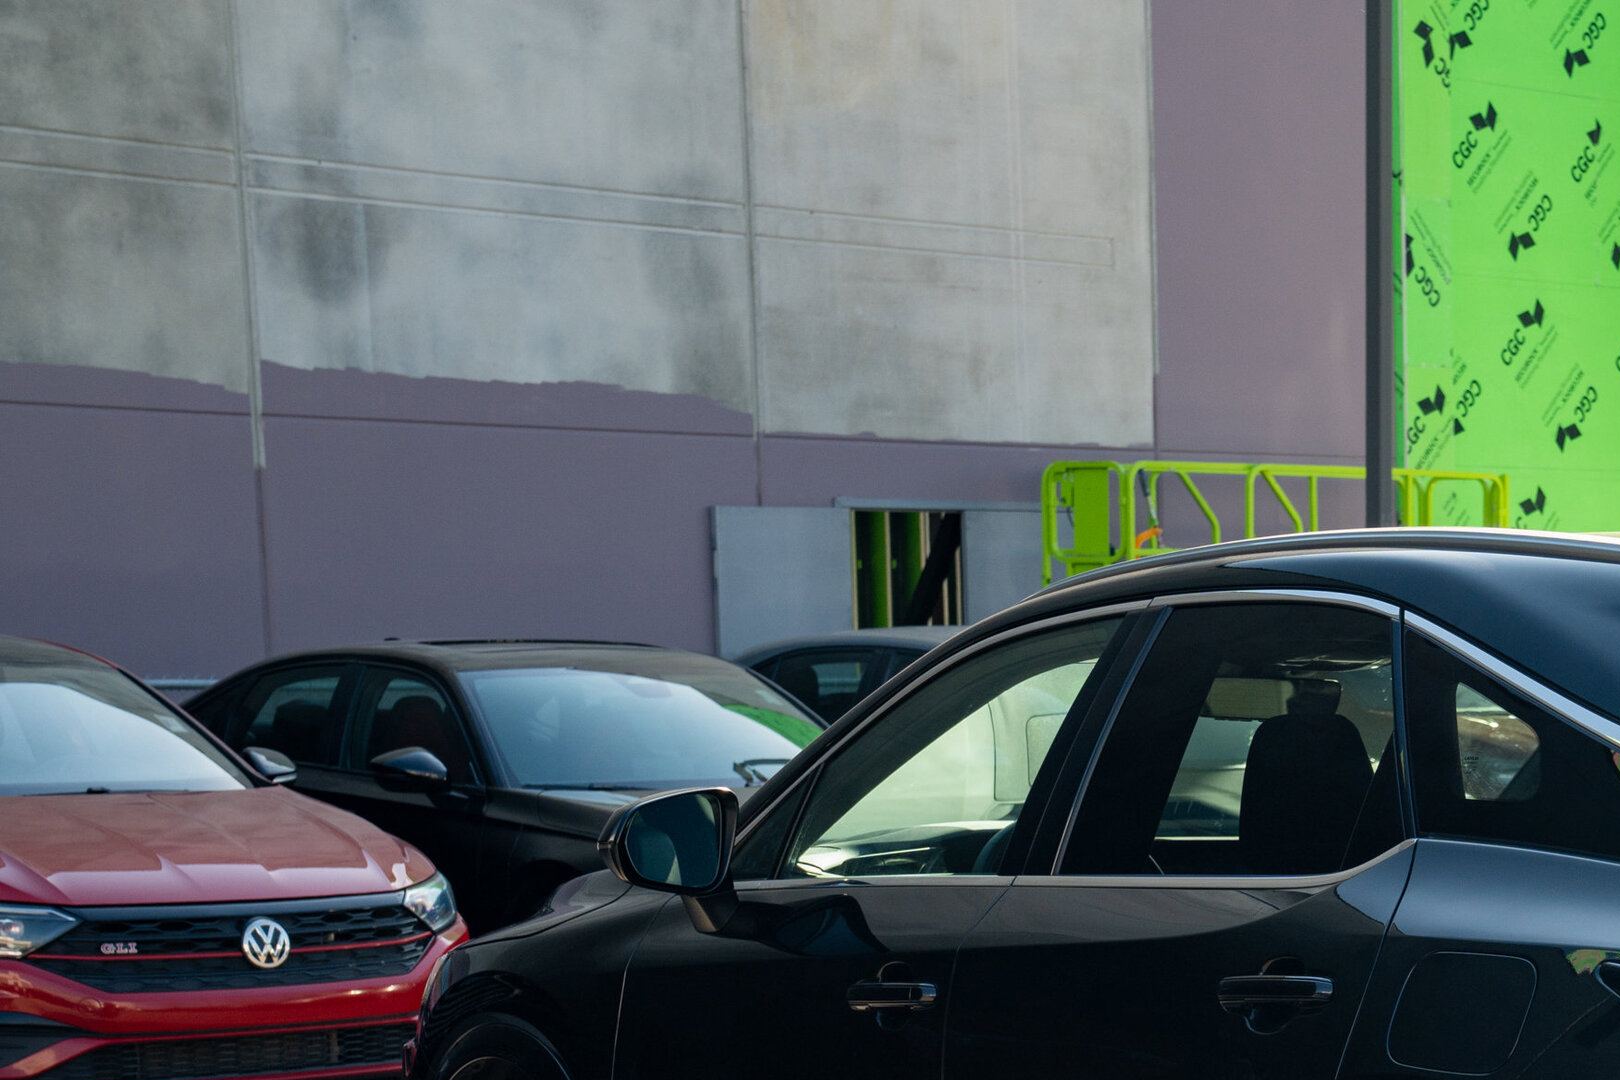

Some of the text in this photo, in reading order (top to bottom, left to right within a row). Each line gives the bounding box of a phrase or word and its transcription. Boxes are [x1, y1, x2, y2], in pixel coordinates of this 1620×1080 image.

[1582, 12, 1607, 49] CGC
[1452, 130, 1478, 169] CGC
[1571, 145, 1596, 183] CGC
[1528, 194, 1553, 232] CGC
[1414, 265, 1441, 307] CGC
[1501, 328, 1526, 366] CGC
[1457, 379, 1482, 418] CGC
[1573, 386, 1598, 423] CGC
[1406, 415, 1426, 454] GC
[100, 942, 138, 954] GLI
